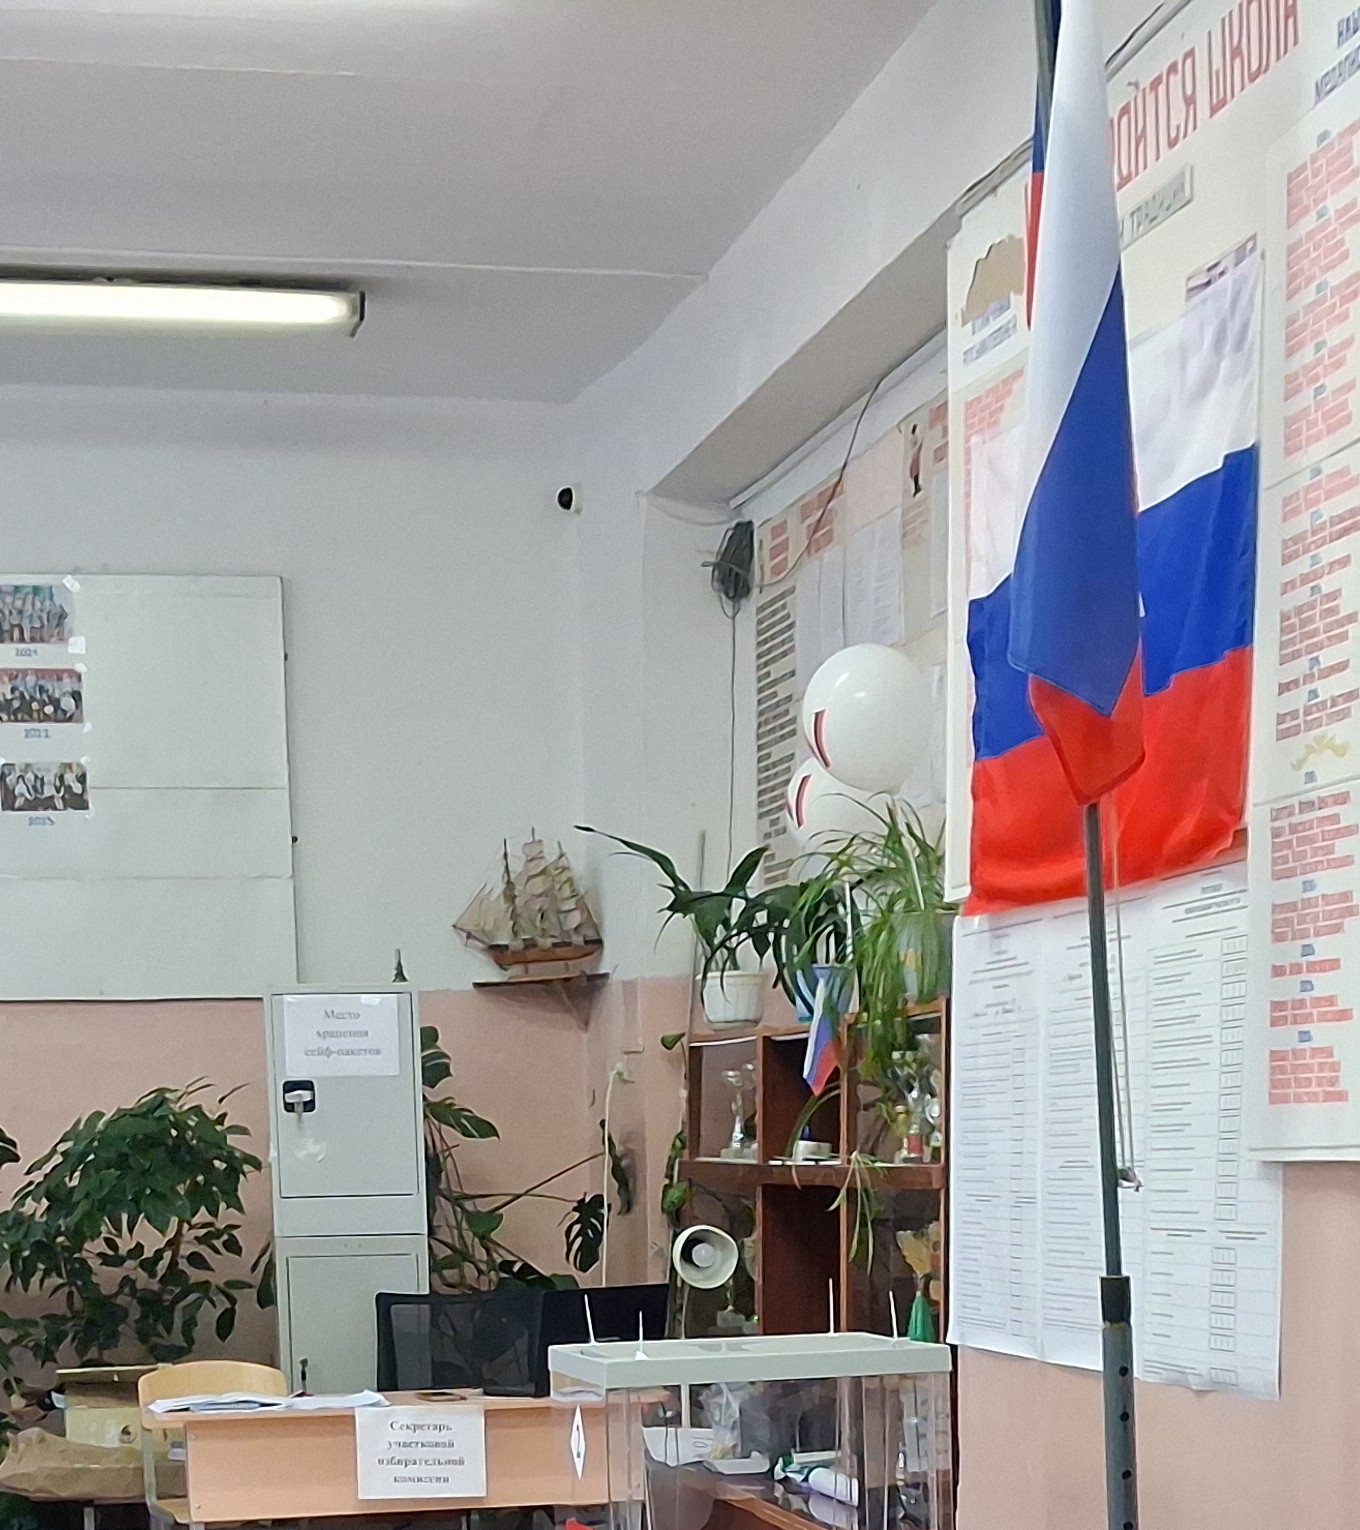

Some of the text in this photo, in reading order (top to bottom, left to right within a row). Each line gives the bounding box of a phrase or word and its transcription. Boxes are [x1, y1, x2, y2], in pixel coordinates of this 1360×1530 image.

[1107, 46, 1198, 192] ДИТСЯ
[390, 1421, 453, 1433] Секретарь
[387, 1440, 455, 1450] участковой
[377, 1456, 466, 1468] избирательной
